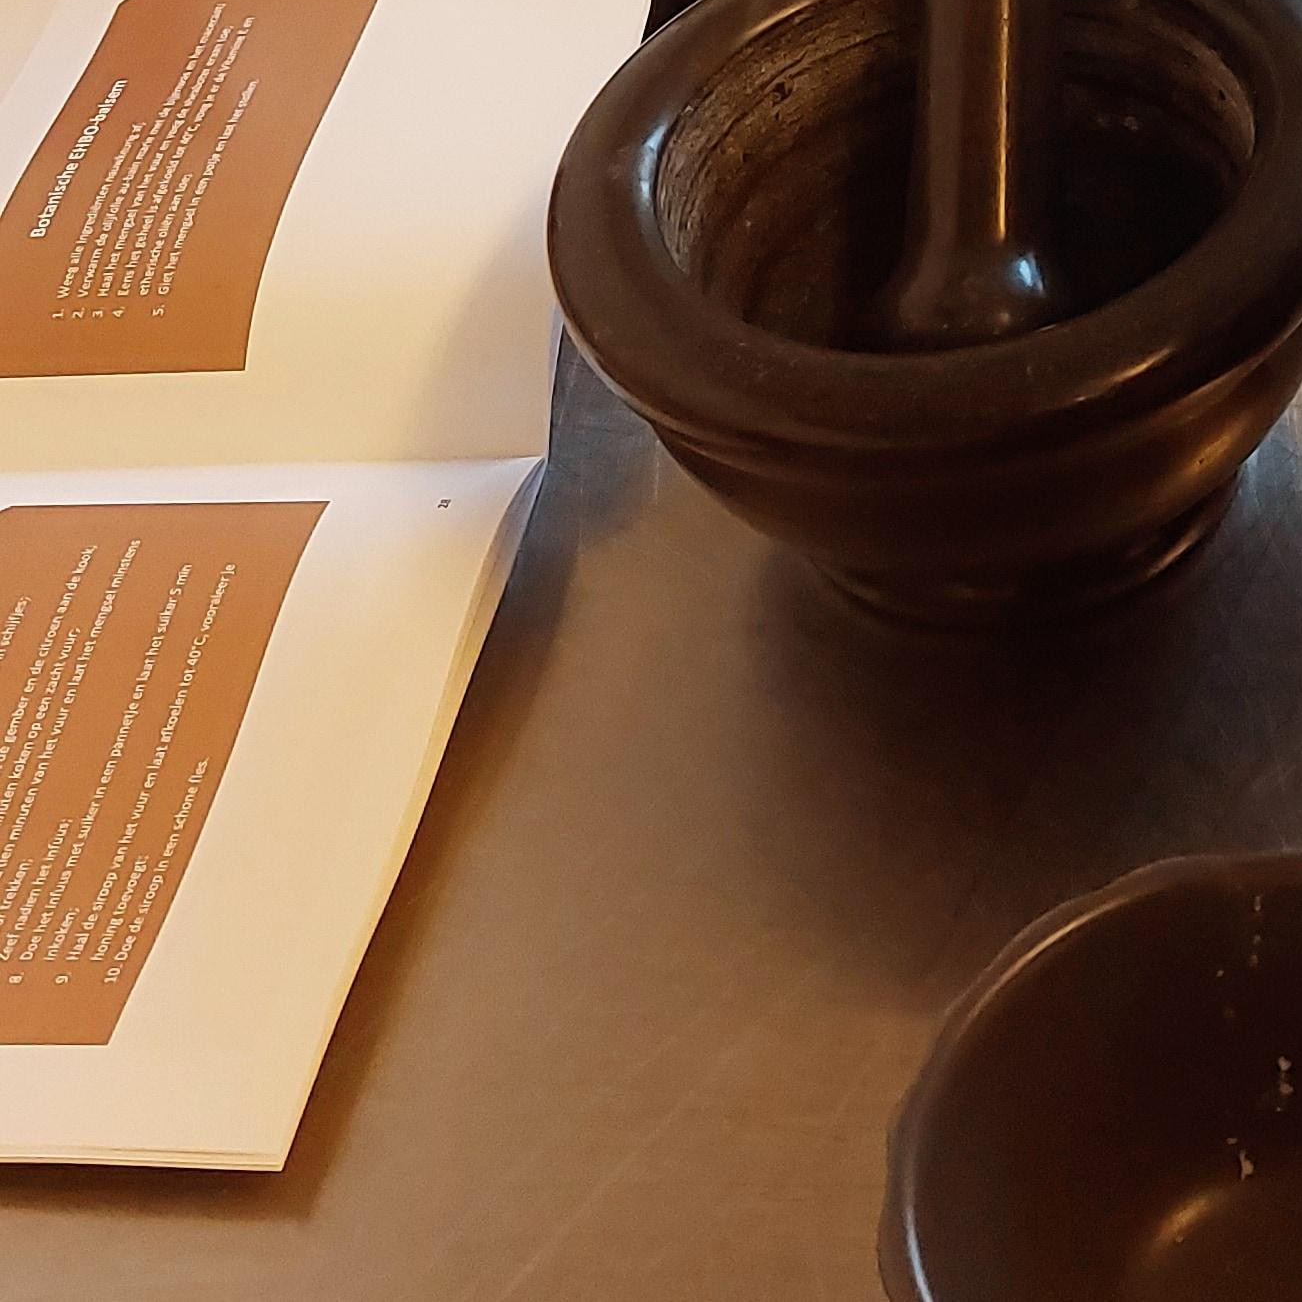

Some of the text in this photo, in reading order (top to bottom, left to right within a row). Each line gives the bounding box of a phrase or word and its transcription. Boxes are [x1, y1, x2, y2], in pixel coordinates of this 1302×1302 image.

[30, 163, 79, 237] Botanische
[77, 248, 103, 298] Verwarm
[437, 499, 451, 509] 28
[77, 640, 97, 661] het
[63, 689, 77, 704] en
[50, 707, 69, 735] vuur
[37, 738, 58, 759] het
[146, 745, 168, 769] laat
[31, 762, 49, 785] van
[144, 772, 158, 788] en
[9, 788, 38, 840] minuten
[32, 912, 54, 932] het
[100, 760, 118, 784] een
[132, 684, 145, 700] en
[131, 791, 150, 820] vuur
[117, 823, 138, 844] het
[111, 846, 128, 869] van
[31, 865, 52, 885] het
[128, 917, 145, 933] de
[162, 833, 180, 857] een
[81, 914, 98, 930] de
